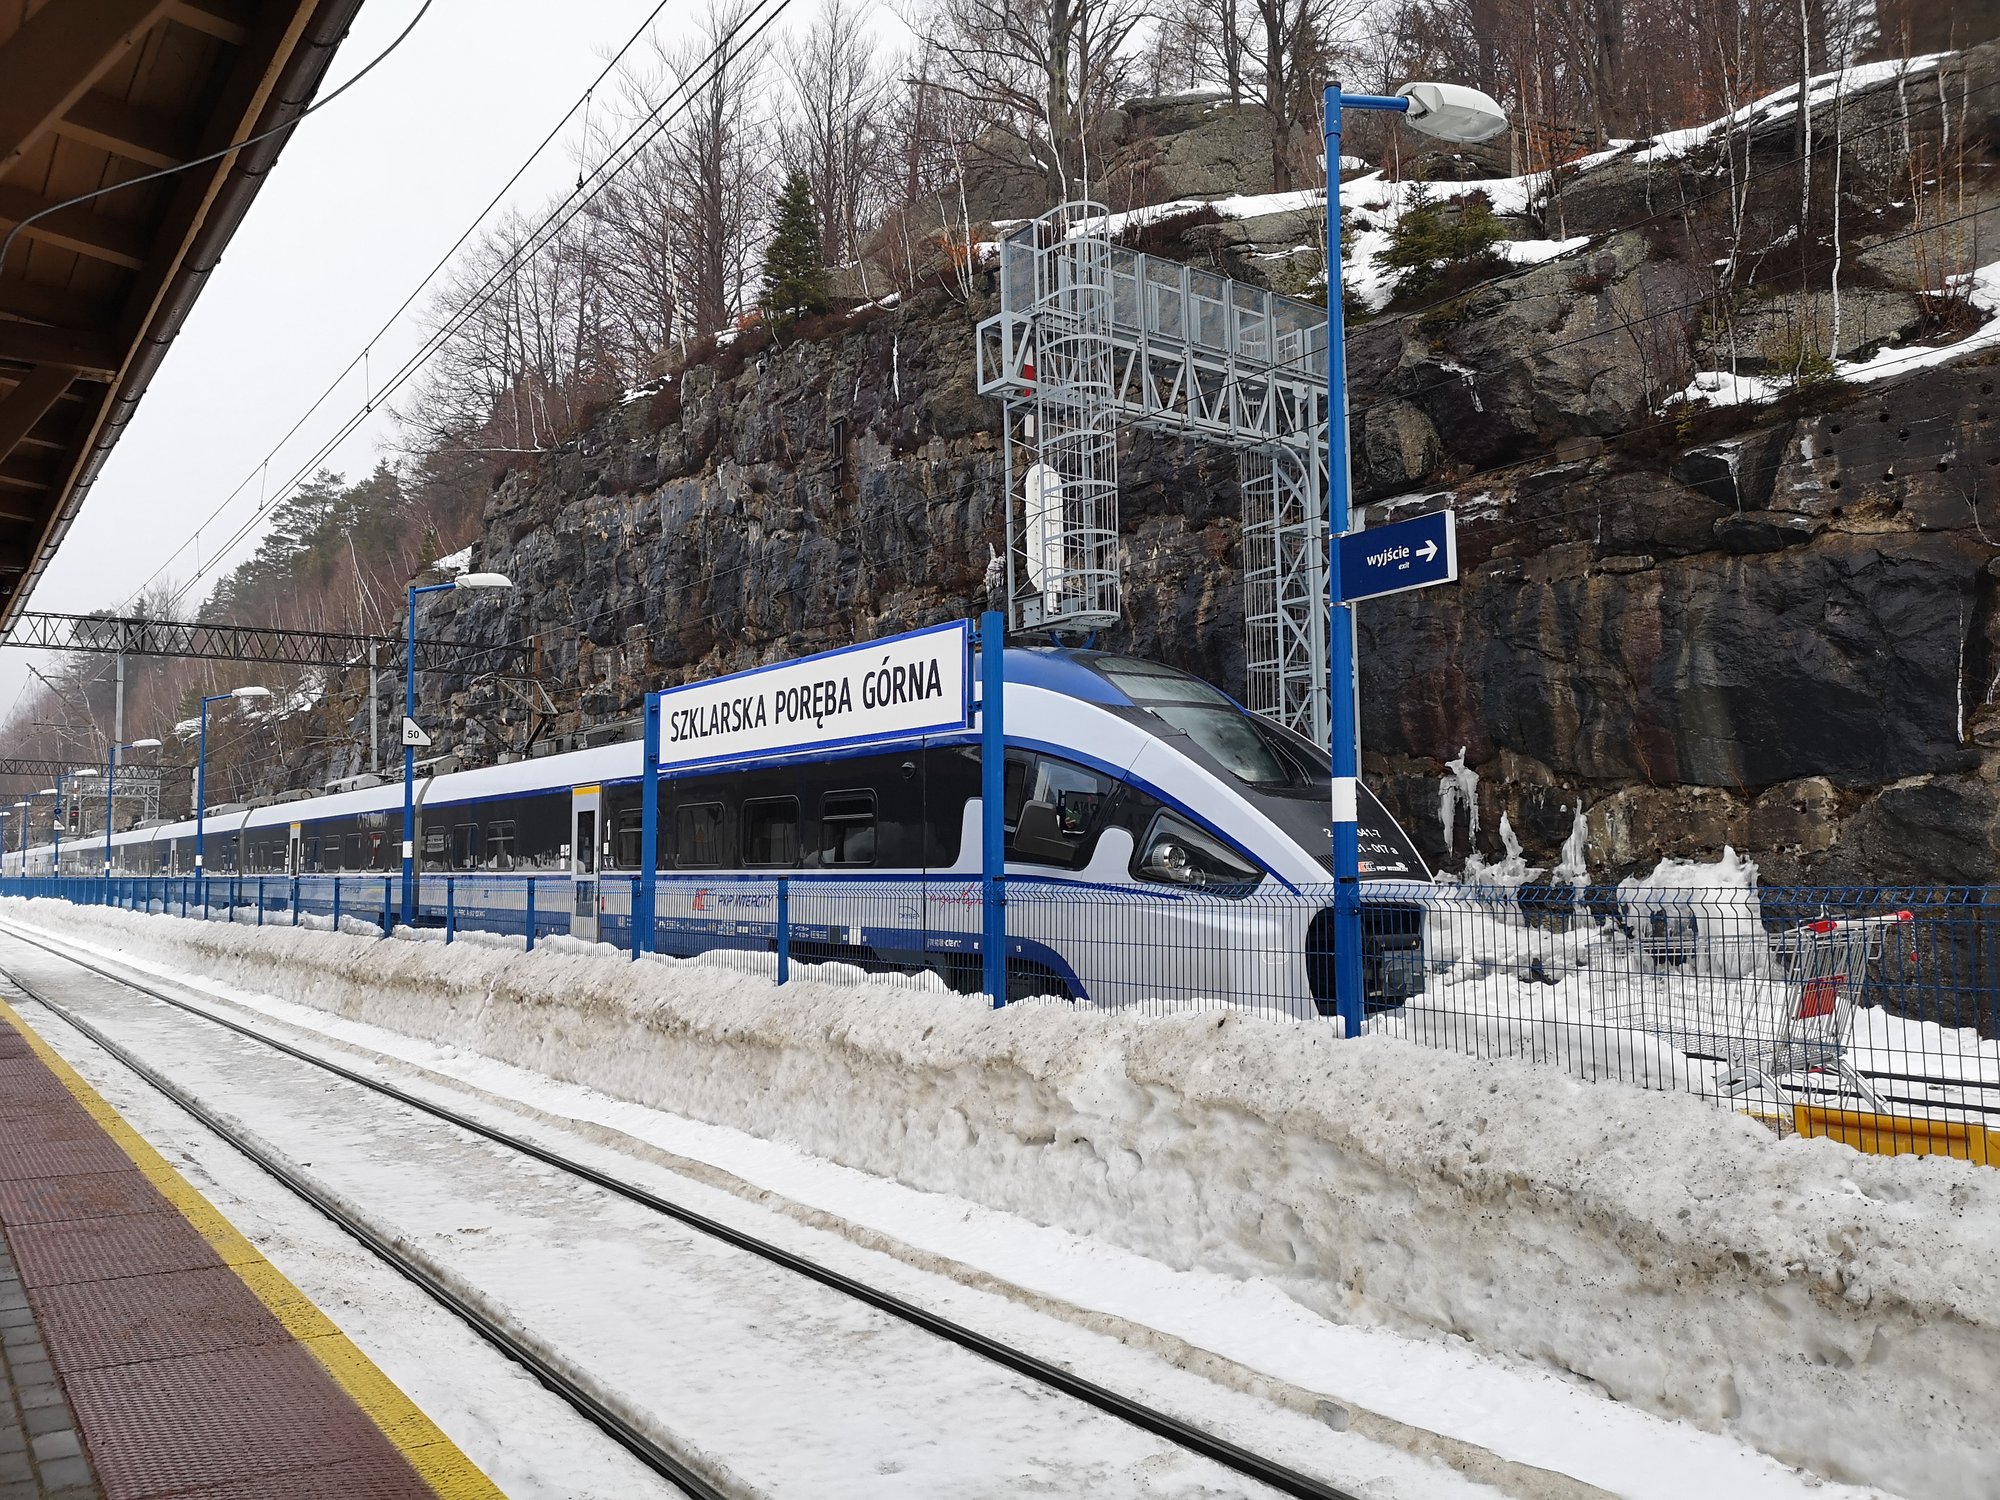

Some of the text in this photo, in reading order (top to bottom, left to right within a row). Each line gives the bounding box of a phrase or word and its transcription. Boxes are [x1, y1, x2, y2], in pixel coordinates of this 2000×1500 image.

[1366, 545, 1410, 568] wyjście
[1398, 561, 1410, 570] exit
[670, 655, 943, 743] SZKLARSKA PORĘBA GÓRNA
[407, 730, 420, 739] 50
[1371, 843, 1390, 854] 017
